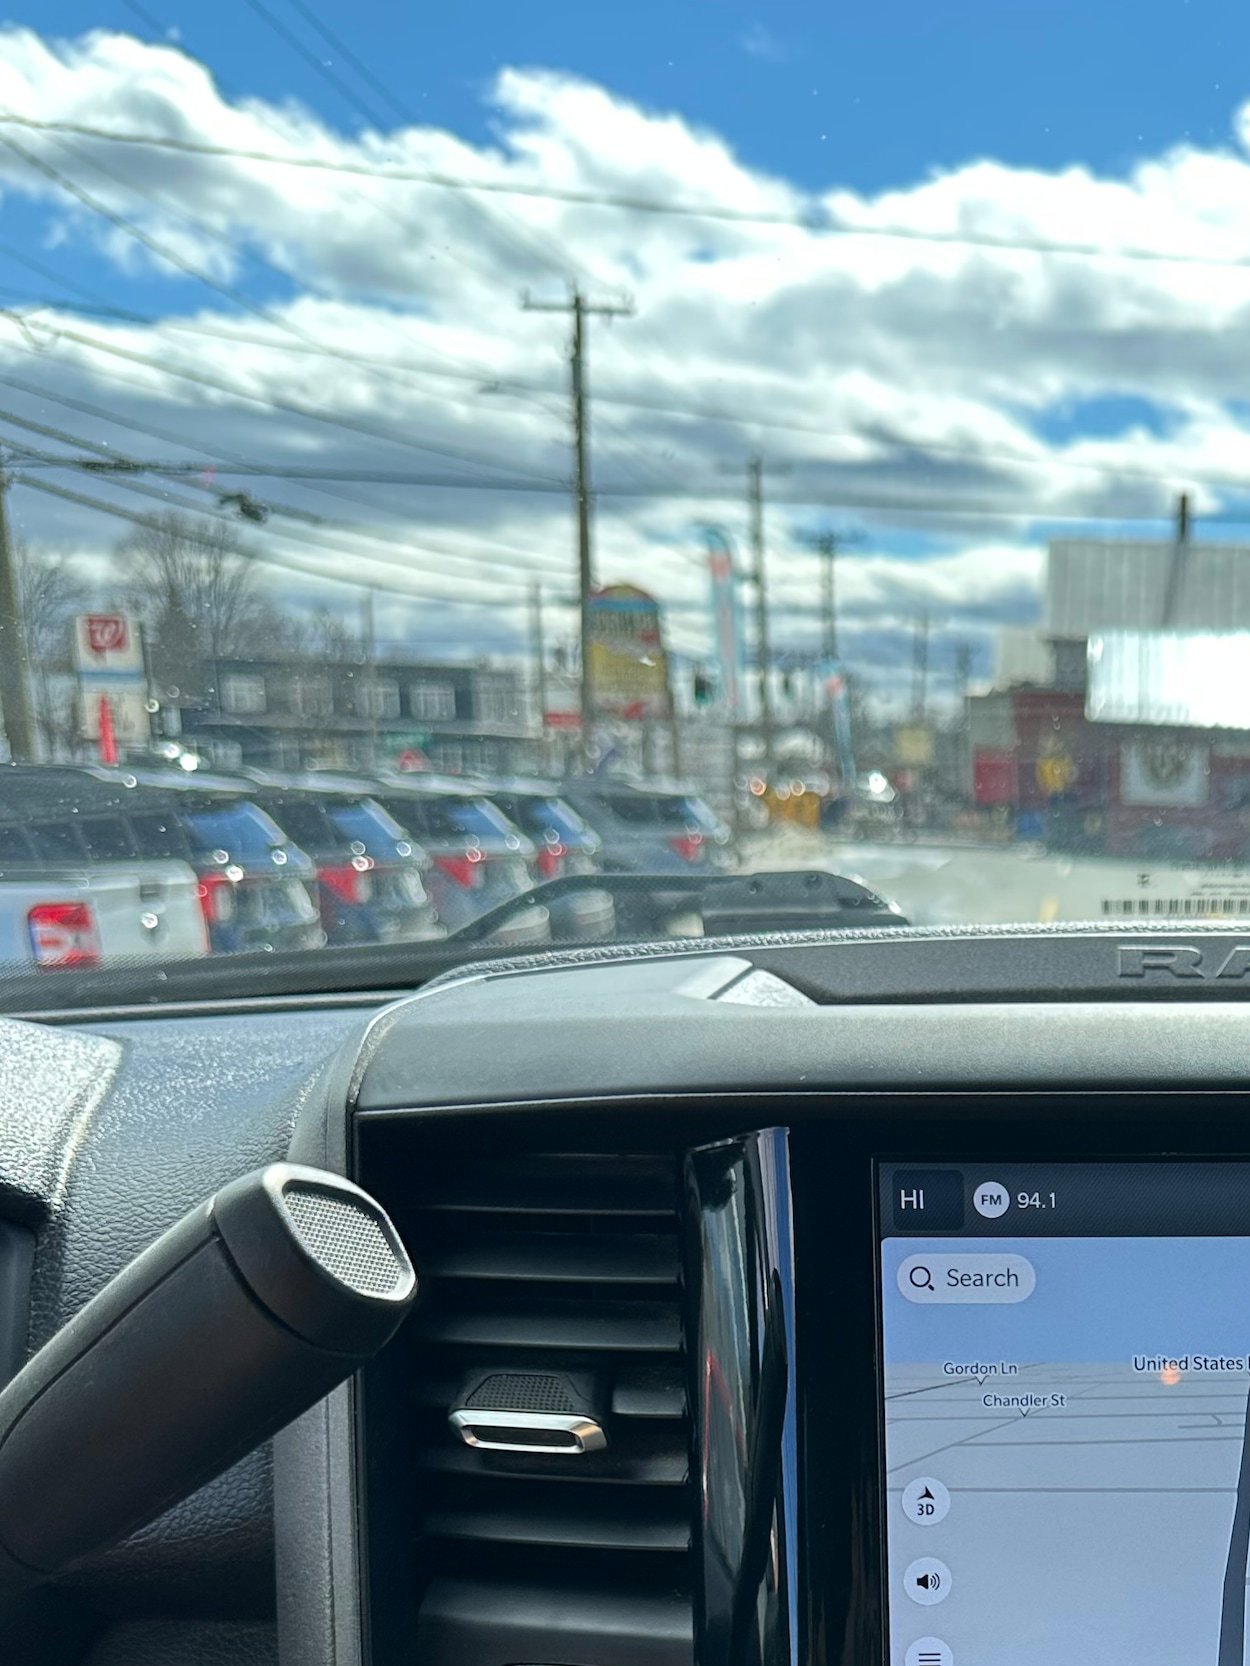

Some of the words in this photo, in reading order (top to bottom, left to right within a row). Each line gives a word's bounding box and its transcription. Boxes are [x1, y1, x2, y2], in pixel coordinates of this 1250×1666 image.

[900, 1190, 924, 1209] HI
[981, 1194, 1002, 1206] FM
[1017, 1192, 1056, 1209] 94.1
[946, 1268, 1019, 1288] Search
[944, 1362, 999, 1375] Gordon
[1002, 1363, 1017, 1375] Ln
[1134, 1356, 1189, 1371] United
[1193, 1356, 1243, 1371] States
[983, 1394, 1048, 1407] Chandler
[1051, 1395, 1065, 1407] St
[917, 1504, 935, 1516] 3D
